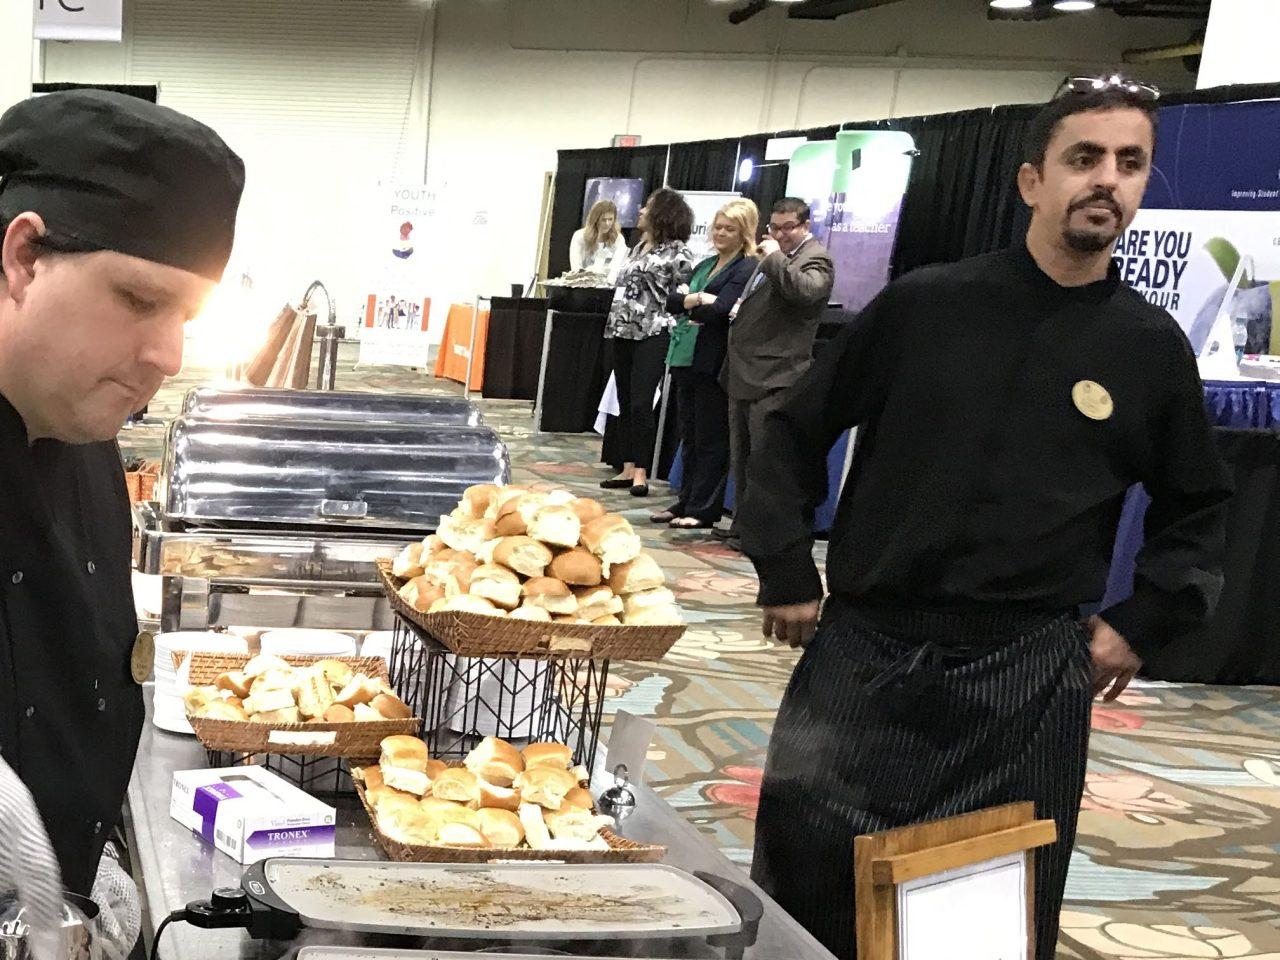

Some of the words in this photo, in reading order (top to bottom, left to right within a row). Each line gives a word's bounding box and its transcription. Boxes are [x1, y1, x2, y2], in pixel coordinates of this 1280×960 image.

[1113, 230, 1151, 256] ARE
[1154, 230, 1193, 259] YOU
[267, 829, 308, 841] TRONEX
